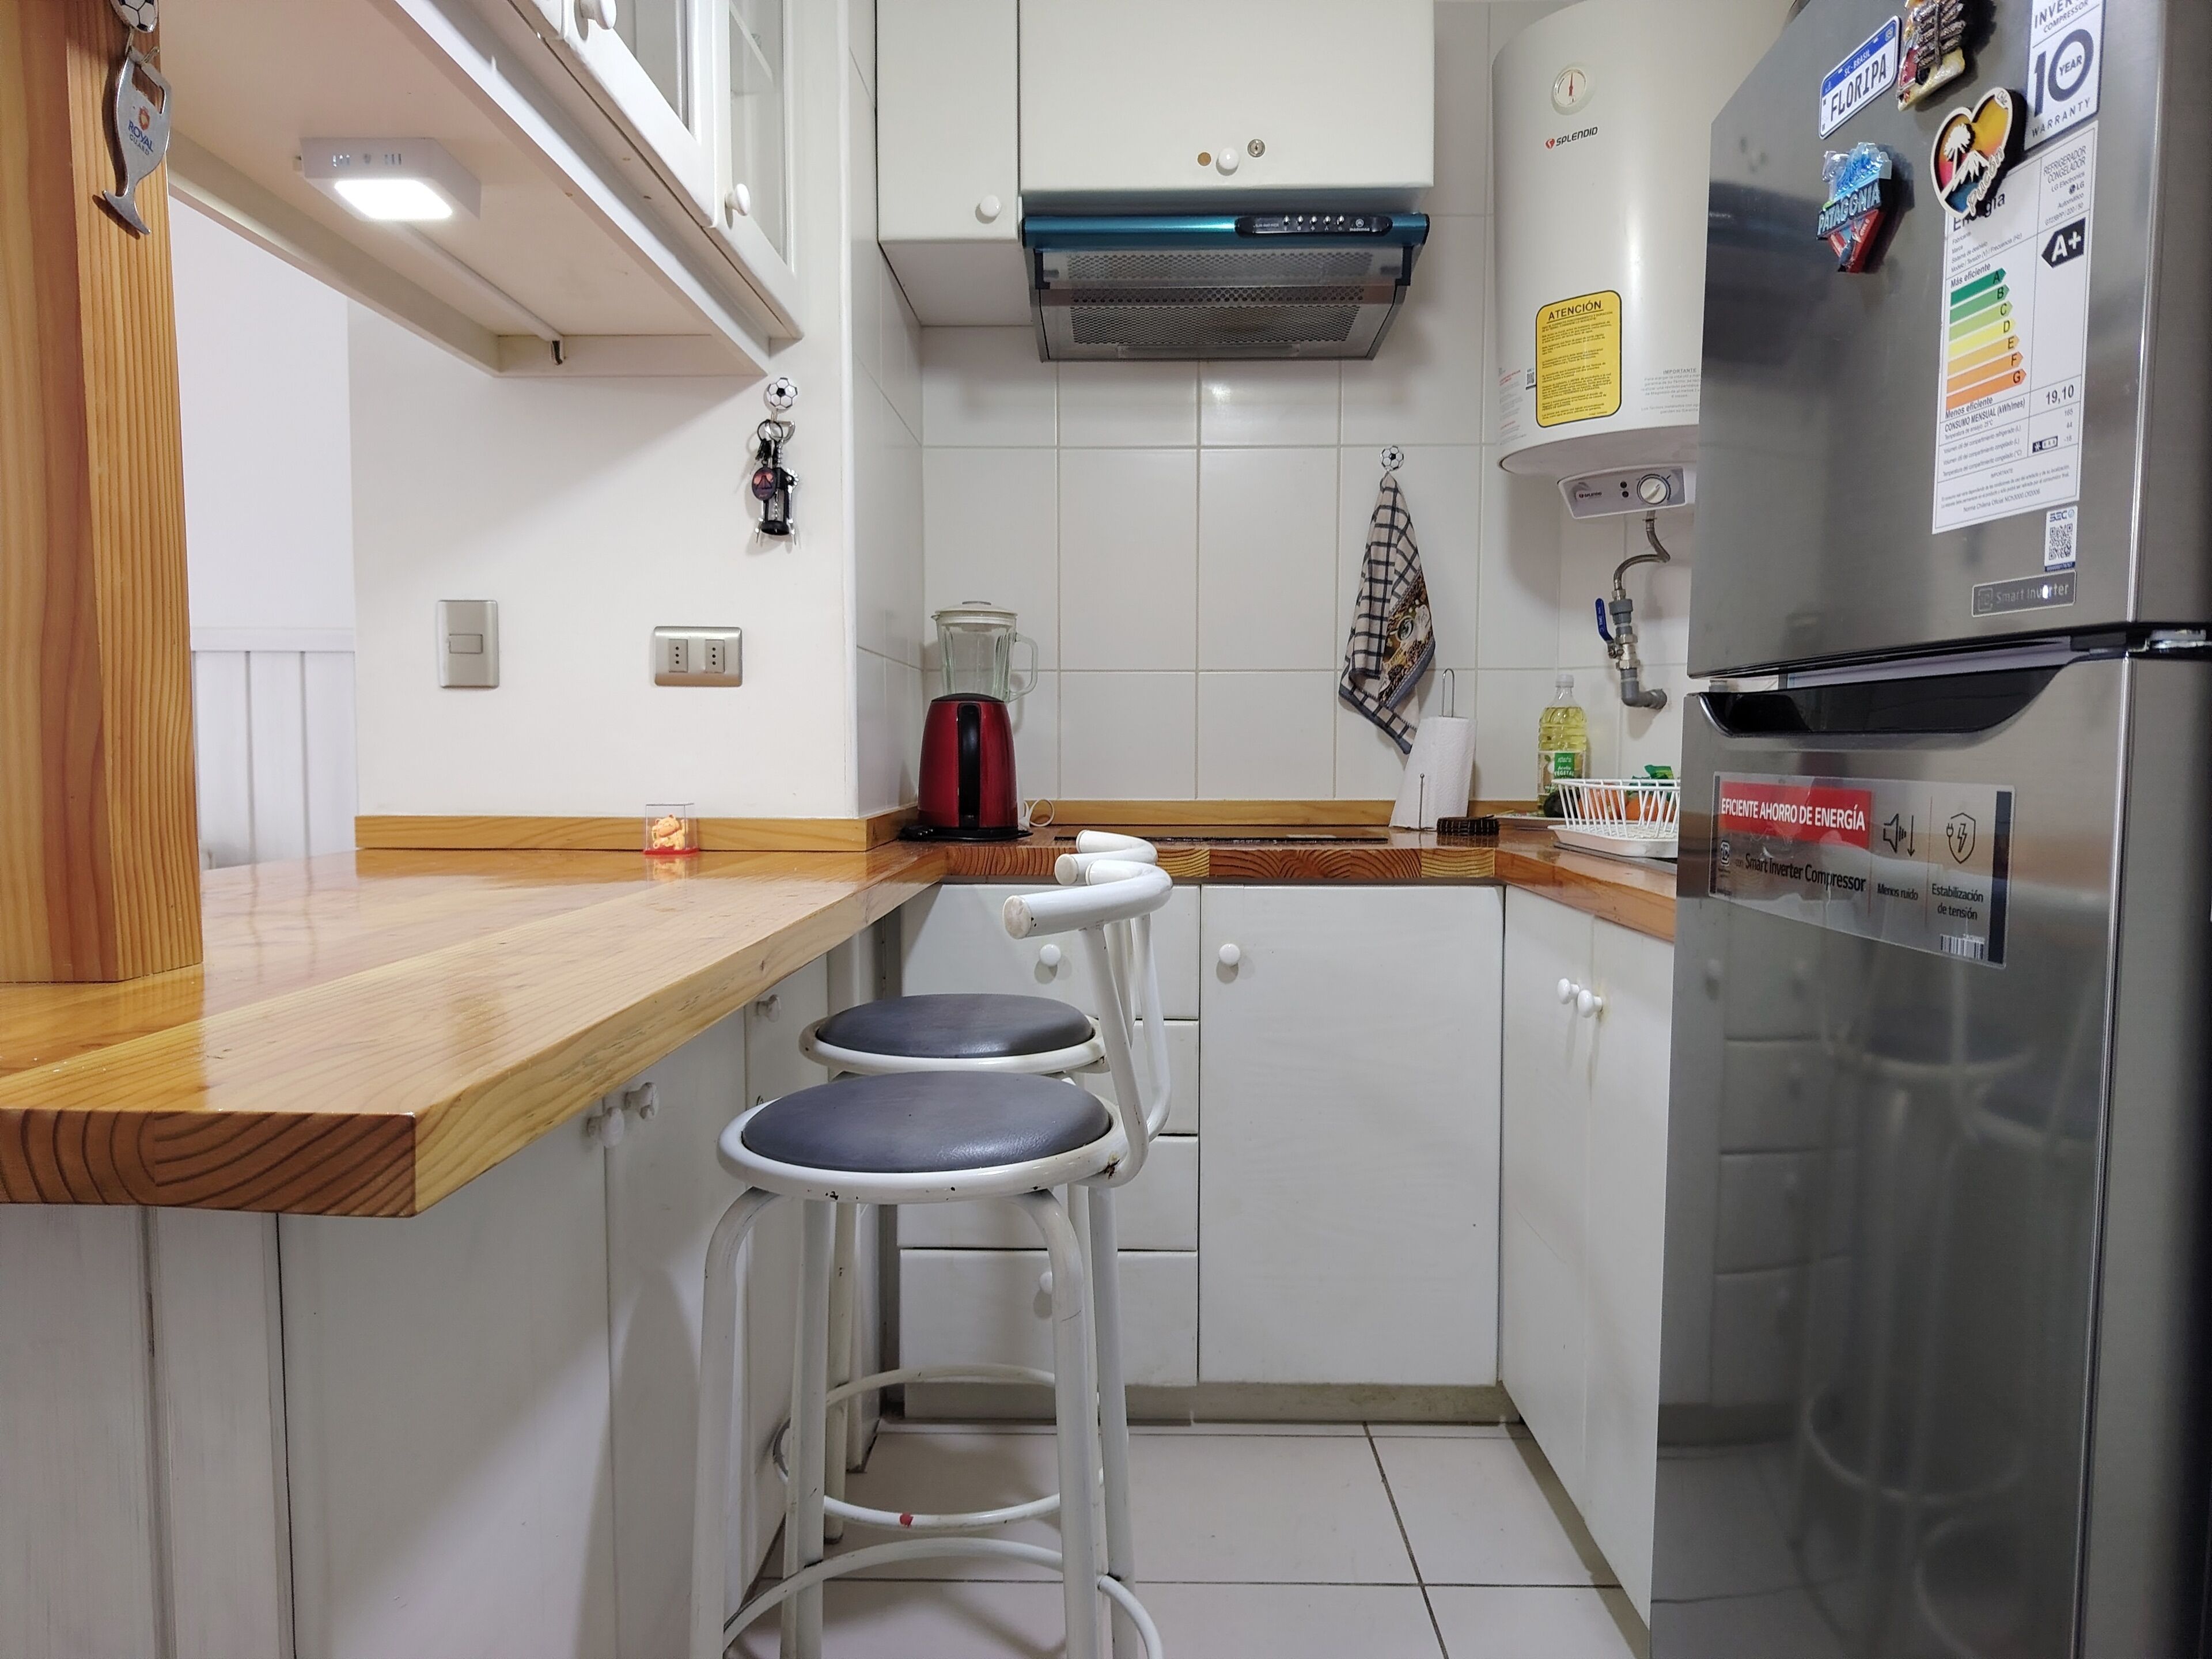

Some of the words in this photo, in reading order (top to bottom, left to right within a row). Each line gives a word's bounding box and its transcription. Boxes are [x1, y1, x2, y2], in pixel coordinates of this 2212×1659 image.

[2044, 1, 2089, 33] COMPRESSOR
[2035, 29, 2094, 118] 10
[2059, 55, 2082, 76] YEAR
[1831, 53, 1887, 122] FLORIPA
[2032, 97, 2091, 137] WARRANTY
[128, 120, 153, 153] ROYAL
[130, 134, 149, 156] GUARD
[1556, 126, 1598, 146] SPLENDID
[2043, 145, 2086, 176] REFRIGERADOR
[2048, 156, 2086, 183] CONGELADOR
[2077, 180, 2085, 191] LG
[1817, 180, 1881, 237] PATAGONIA
[2051, 231, 2081, 262] A+
[1950, 276, 1963, 288] Más
[1964, 263, 1991, 281] eficiente
[1993, 271, 2001, 284] A
[1997, 288, 2004, 300] B
[1548, 300, 1601, 321] ATENCIÓN
[2000, 303, 2007, 316] C
[2003, 320, 2010, 333] D
[2008, 336, 2014, 350] E
[2011, 353, 2017, 366] F
[2013, 371, 2020, 384] G
[2046, 385, 2074, 404] 19,10
[1945, 407, 1964, 419] Menos
[1967, 397, 1993, 412] eficiente
[1945, 416, 1971, 433] CONSUMO
[1971, 408, 1997, 423] MENSUAL
[1997, 397, 2025, 416] (kWh/mes)
[2050, 510, 2067, 522] SEC
[1997, 590, 2024, 604] Smart
[2027, 583, 2069, 599] Invrter
[1721, 798, 1759, 819] EFICIENTE
[1760, 801, 1798, 823] AHORRO
[1799, 805, 1813, 825] DE
[1815, 804, 1866, 831] ENERGÍA
[1745, 853, 1768, 873] Smart
[1770, 857, 1803, 880] Inverter
[1805, 864, 1866, 892] Compressor
[1877, 883, 1899, 897] Menos
[1901, 888, 1919, 900] ruido
[1932, 883, 1984, 903] Estabilización
[1937, 902, 1946, 915] de
[1949, 906, 1978, 921] tensión
